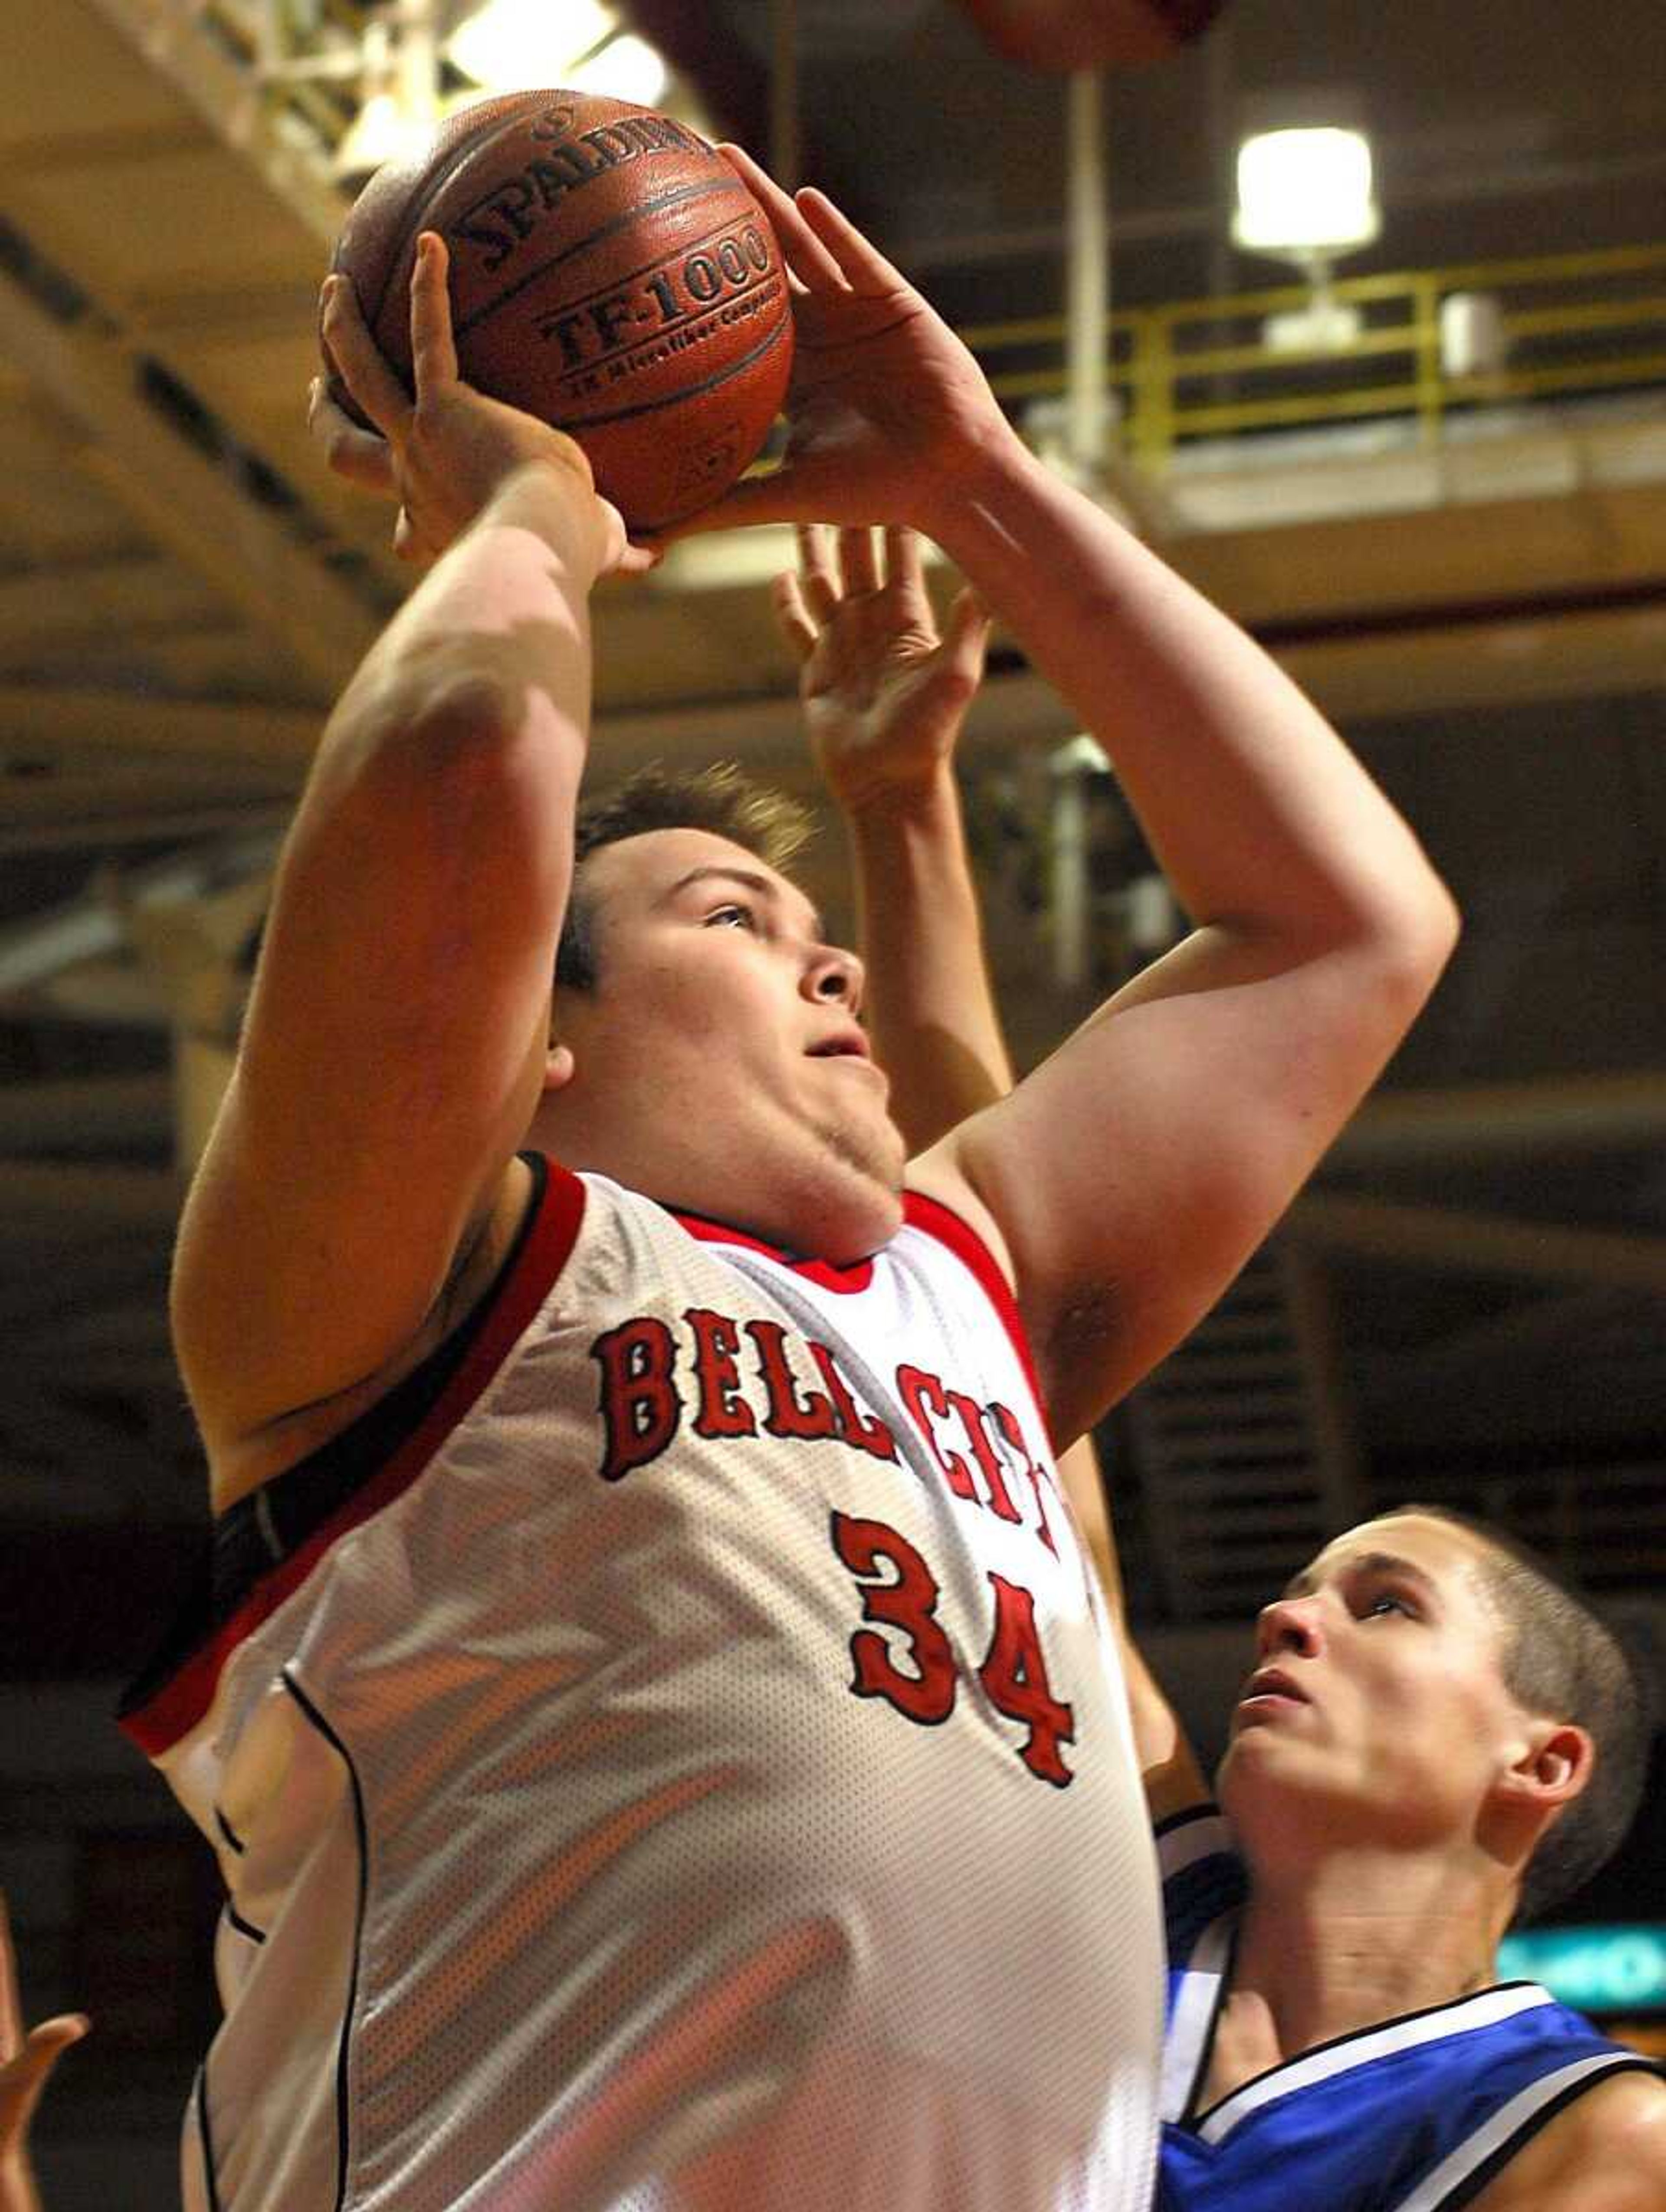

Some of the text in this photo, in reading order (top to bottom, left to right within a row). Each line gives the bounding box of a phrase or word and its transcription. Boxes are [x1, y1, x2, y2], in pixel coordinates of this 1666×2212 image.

[449, 115, 715, 272] SPALDIN
[540, 225, 769, 365] TF-1000
[590, 1308, 902, 1482] BELL
[830, 1509, 1076, 1789] 34
